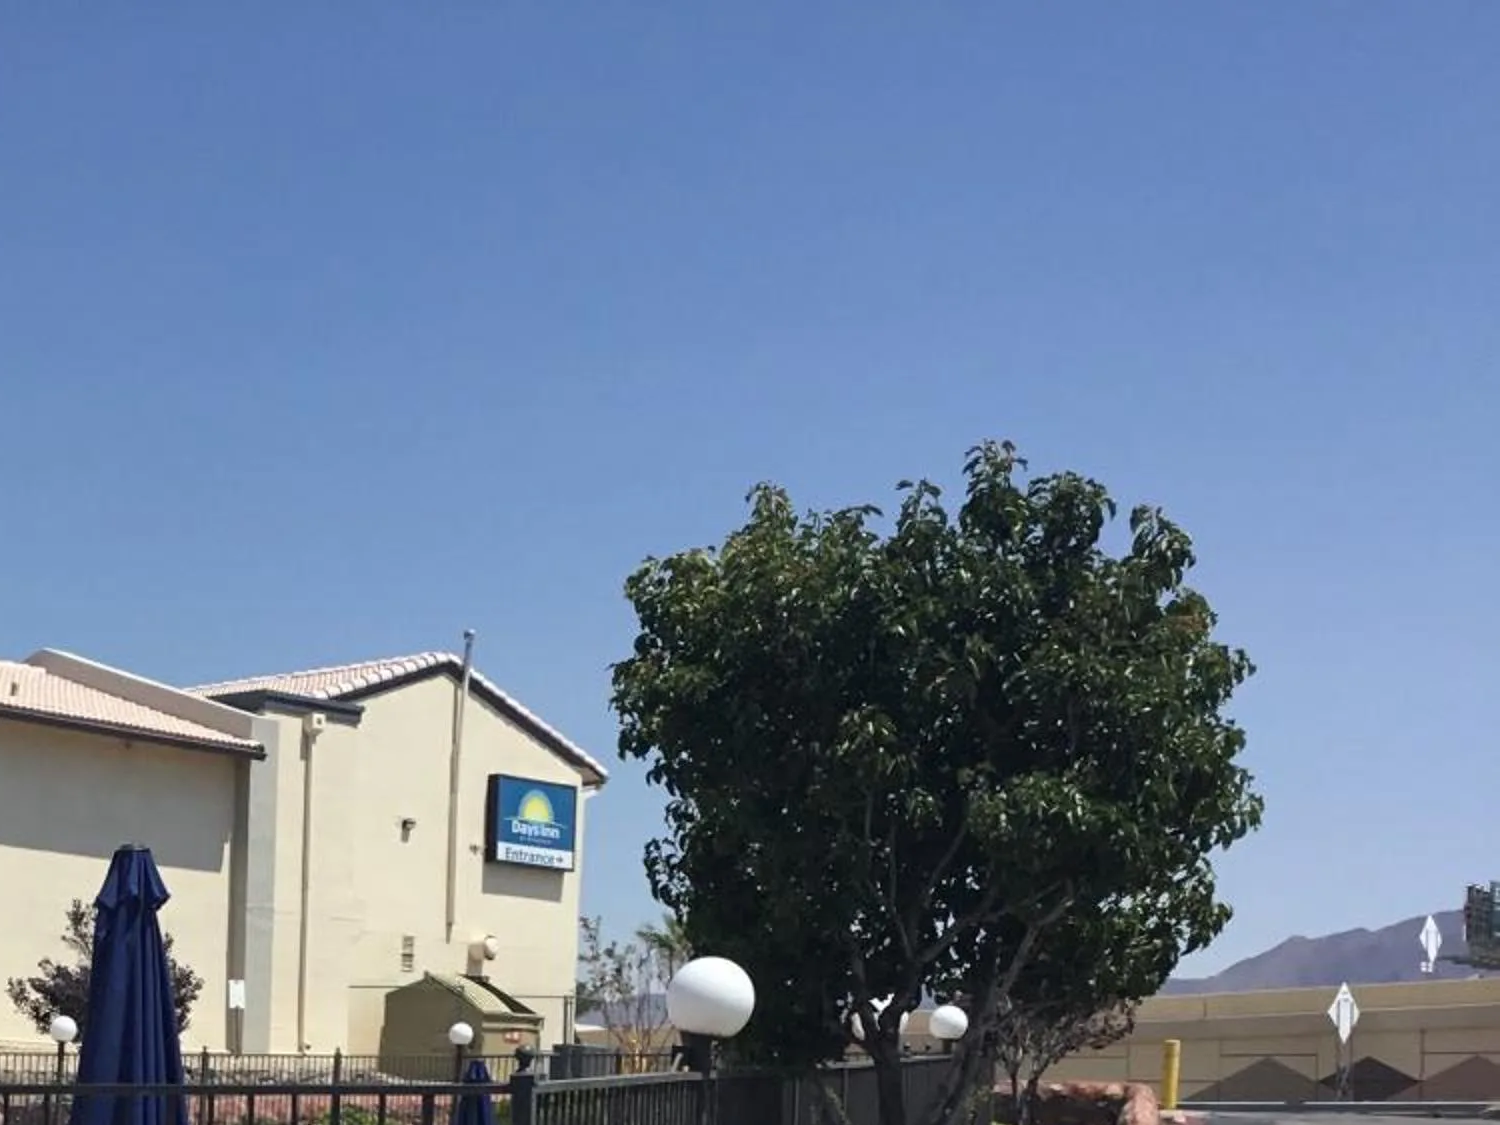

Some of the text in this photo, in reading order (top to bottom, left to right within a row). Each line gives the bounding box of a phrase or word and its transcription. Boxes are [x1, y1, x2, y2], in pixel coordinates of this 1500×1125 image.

[511, 820, 560, 840] Days Inn
[505, 847, 555, 865] Entrance
